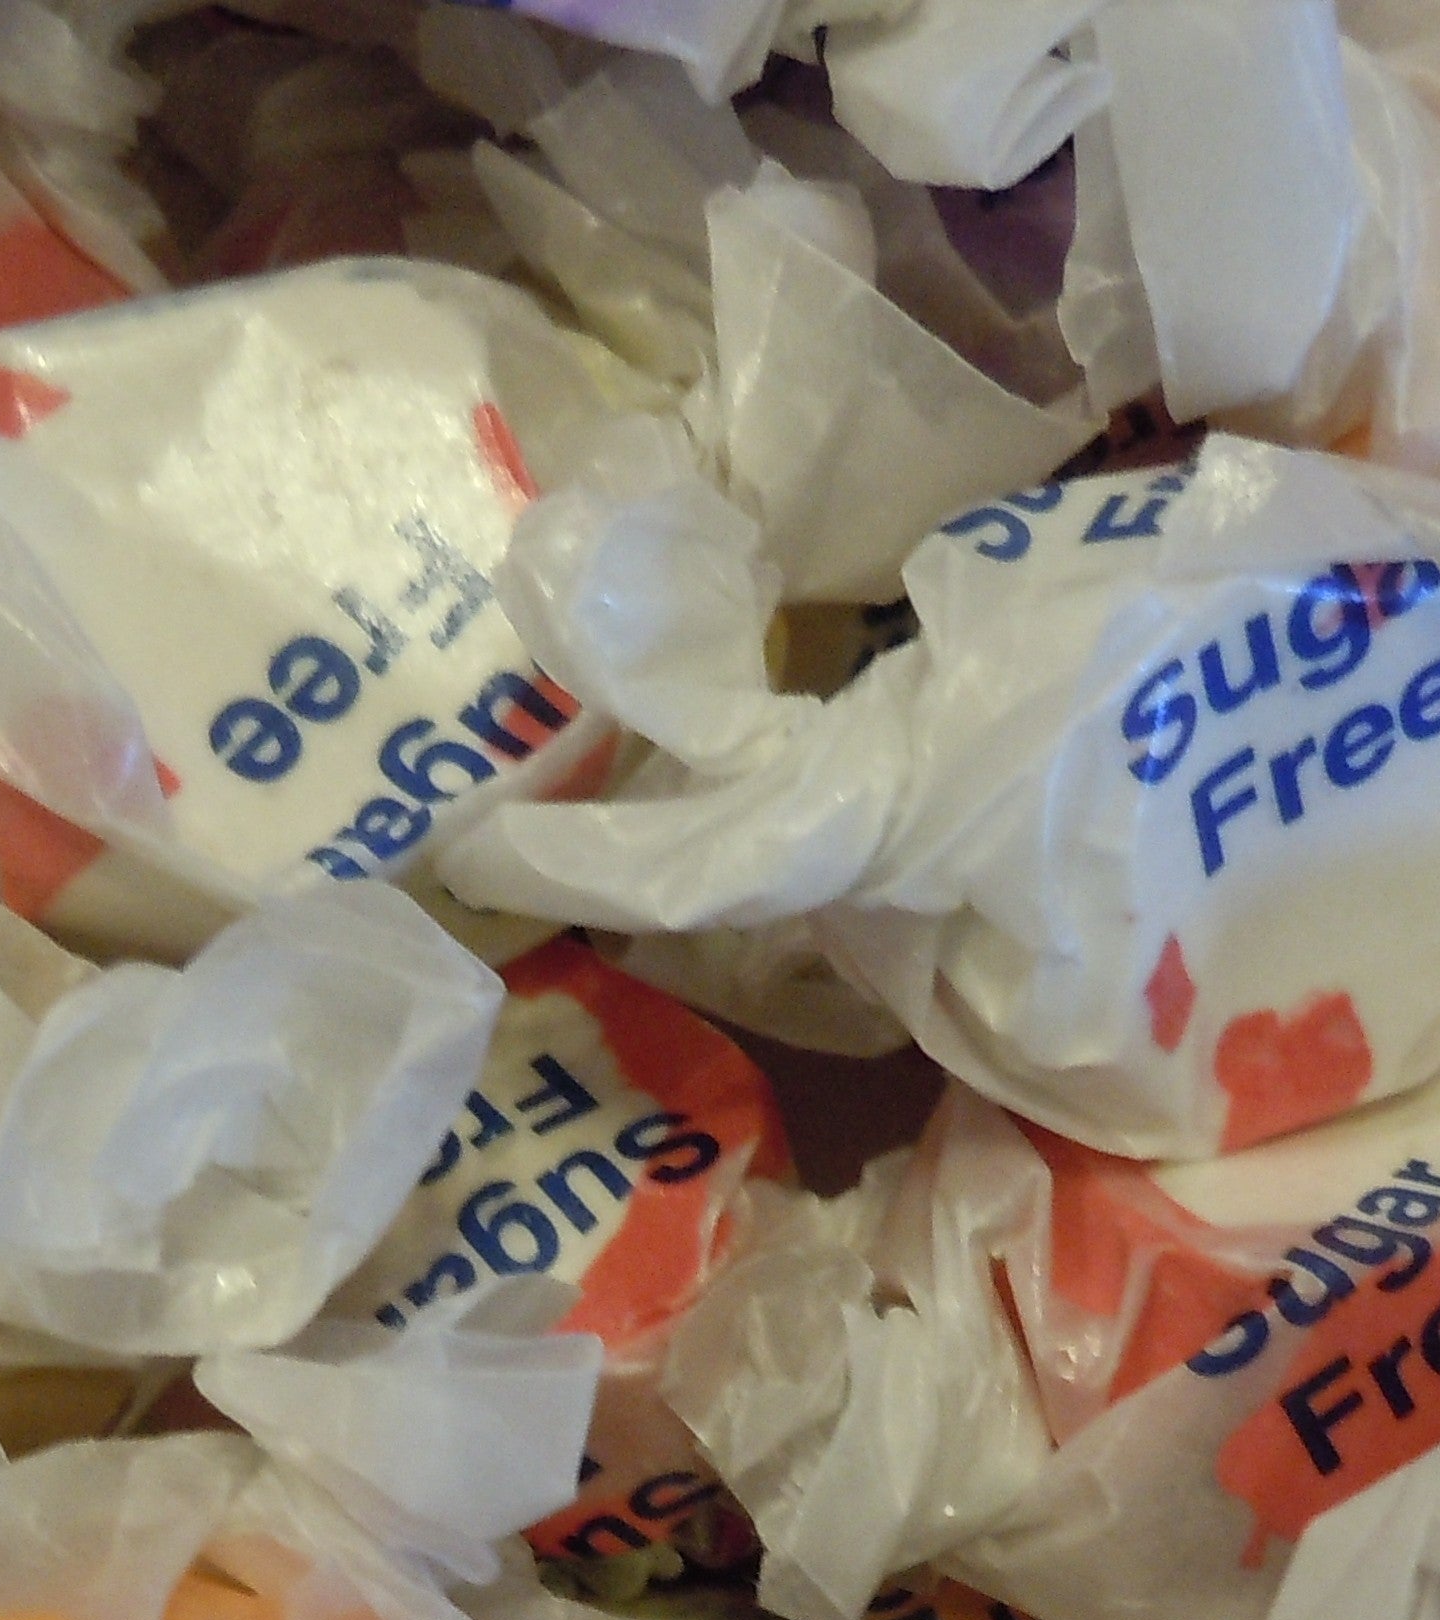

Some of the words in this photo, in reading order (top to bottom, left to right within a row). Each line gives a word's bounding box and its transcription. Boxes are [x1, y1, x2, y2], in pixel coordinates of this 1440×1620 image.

[209, 512, 493, 783] Free
[306, 660, 576, 882] ugar
[374, 1110, 721, 1332] Sug
[418, 1053, 598, 1187] Fr
